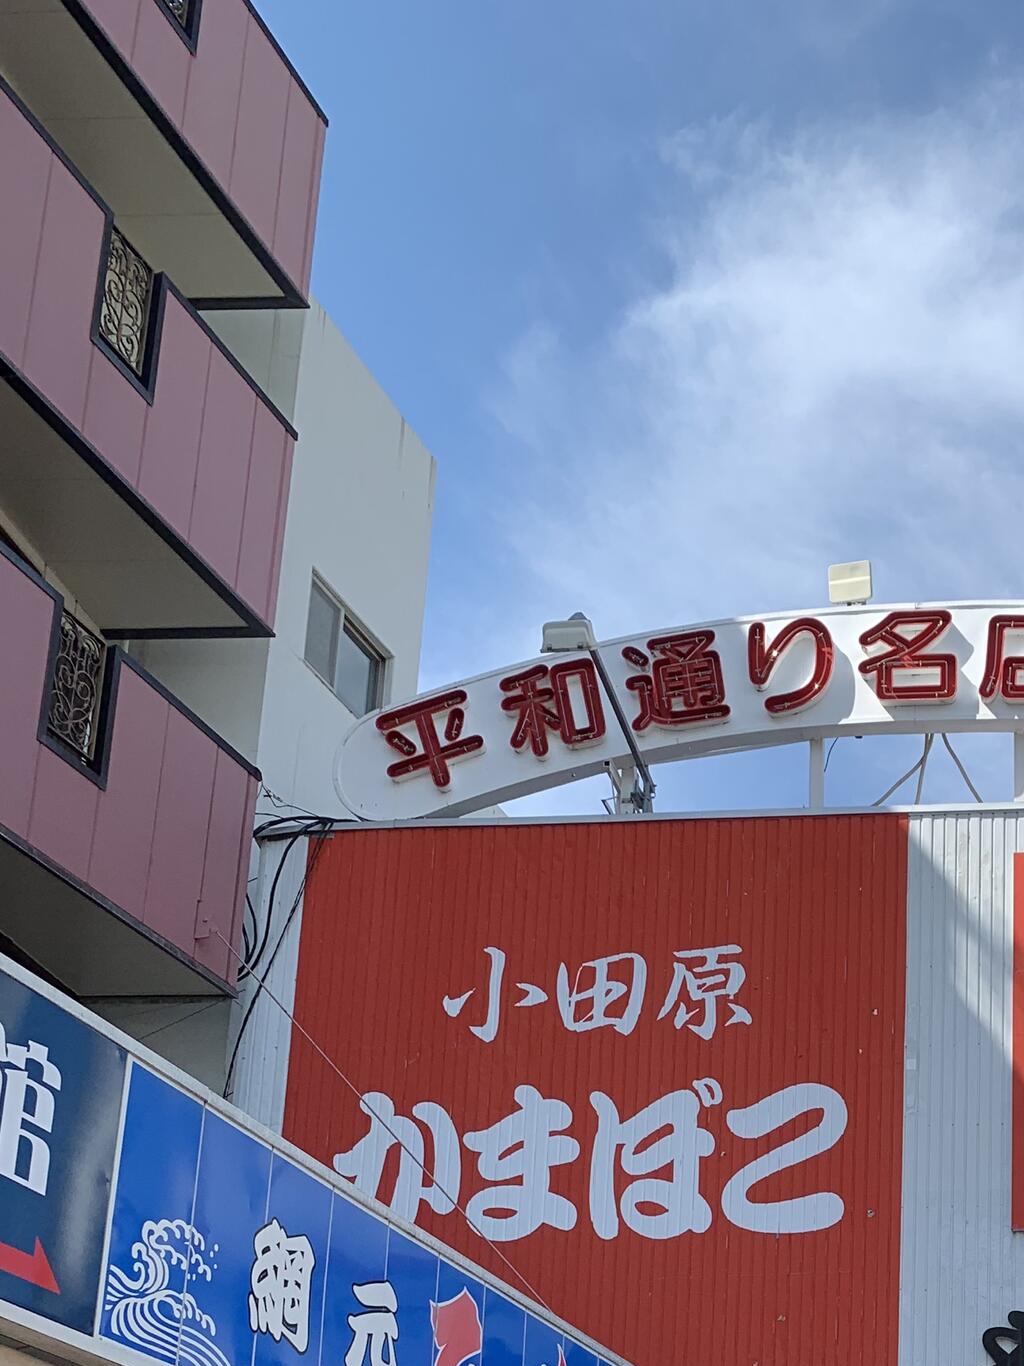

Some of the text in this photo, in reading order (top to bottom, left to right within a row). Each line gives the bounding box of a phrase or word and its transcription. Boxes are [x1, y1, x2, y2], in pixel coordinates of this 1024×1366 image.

[443, 943, 755, 1042] 小田原
[332, 1076, 848, 1243] かまぼこ
